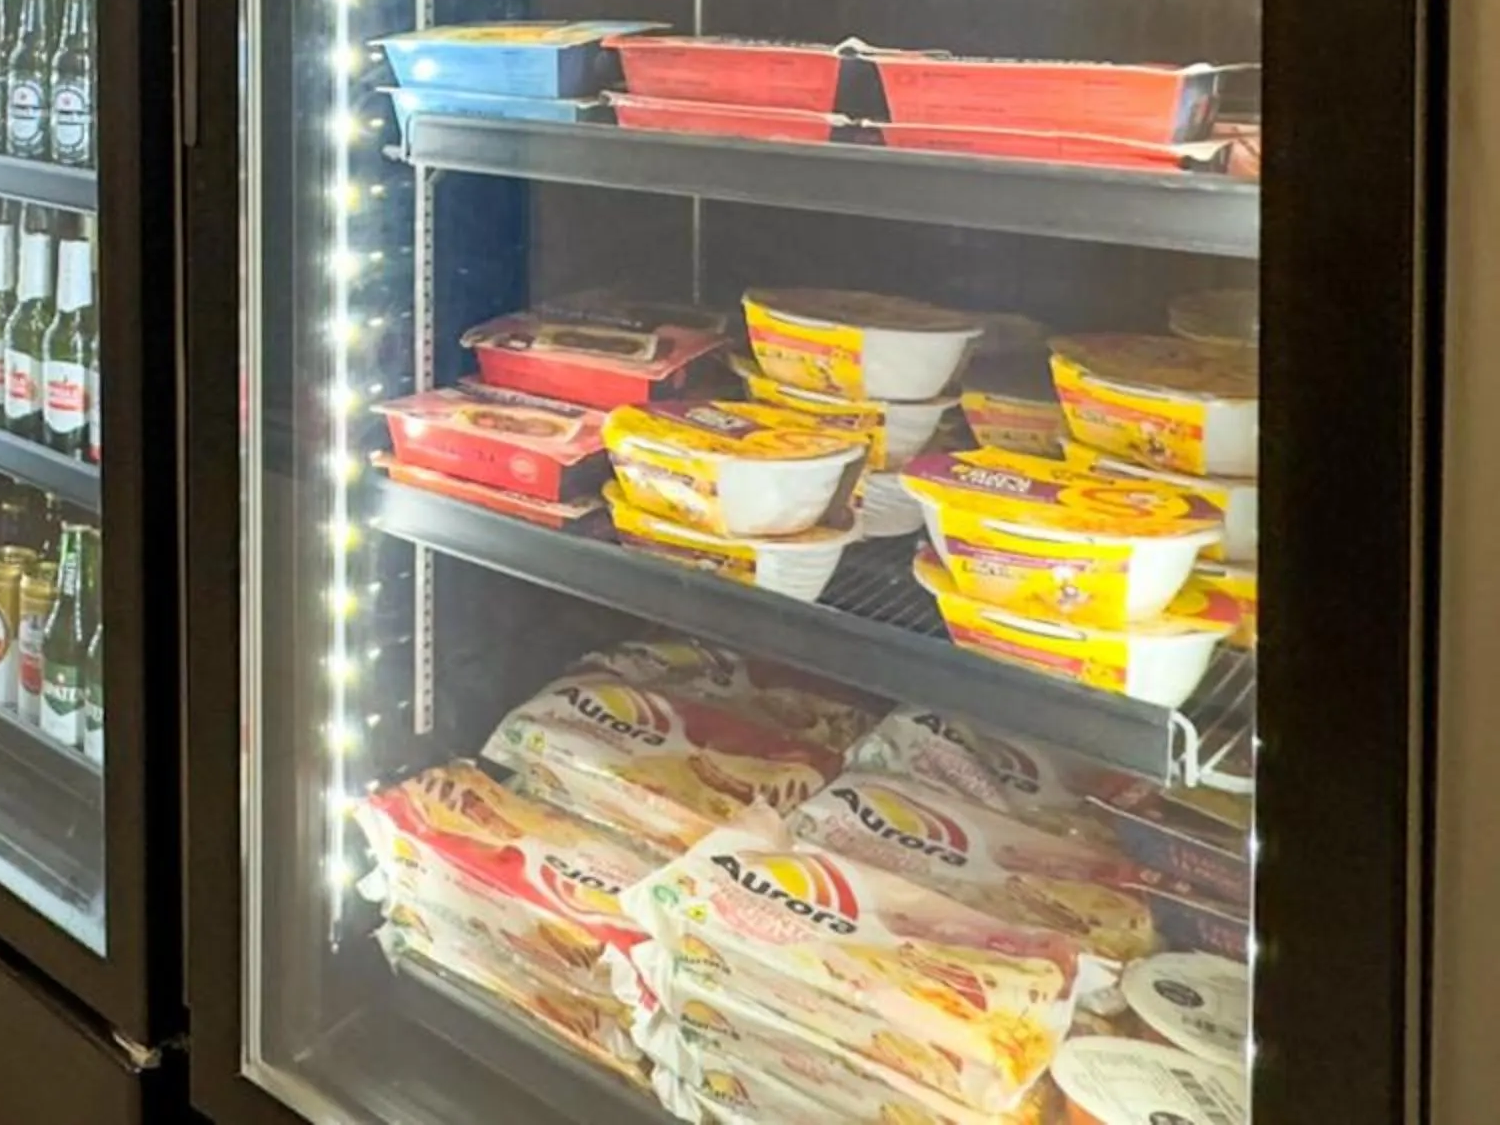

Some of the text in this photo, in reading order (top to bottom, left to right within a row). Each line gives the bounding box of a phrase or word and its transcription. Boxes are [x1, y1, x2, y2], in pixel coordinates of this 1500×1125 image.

[553, 686, 667, 747] Aurora
[830, 787, 968, 867] Aurora
[710, 854, 858, 935] Aurora
